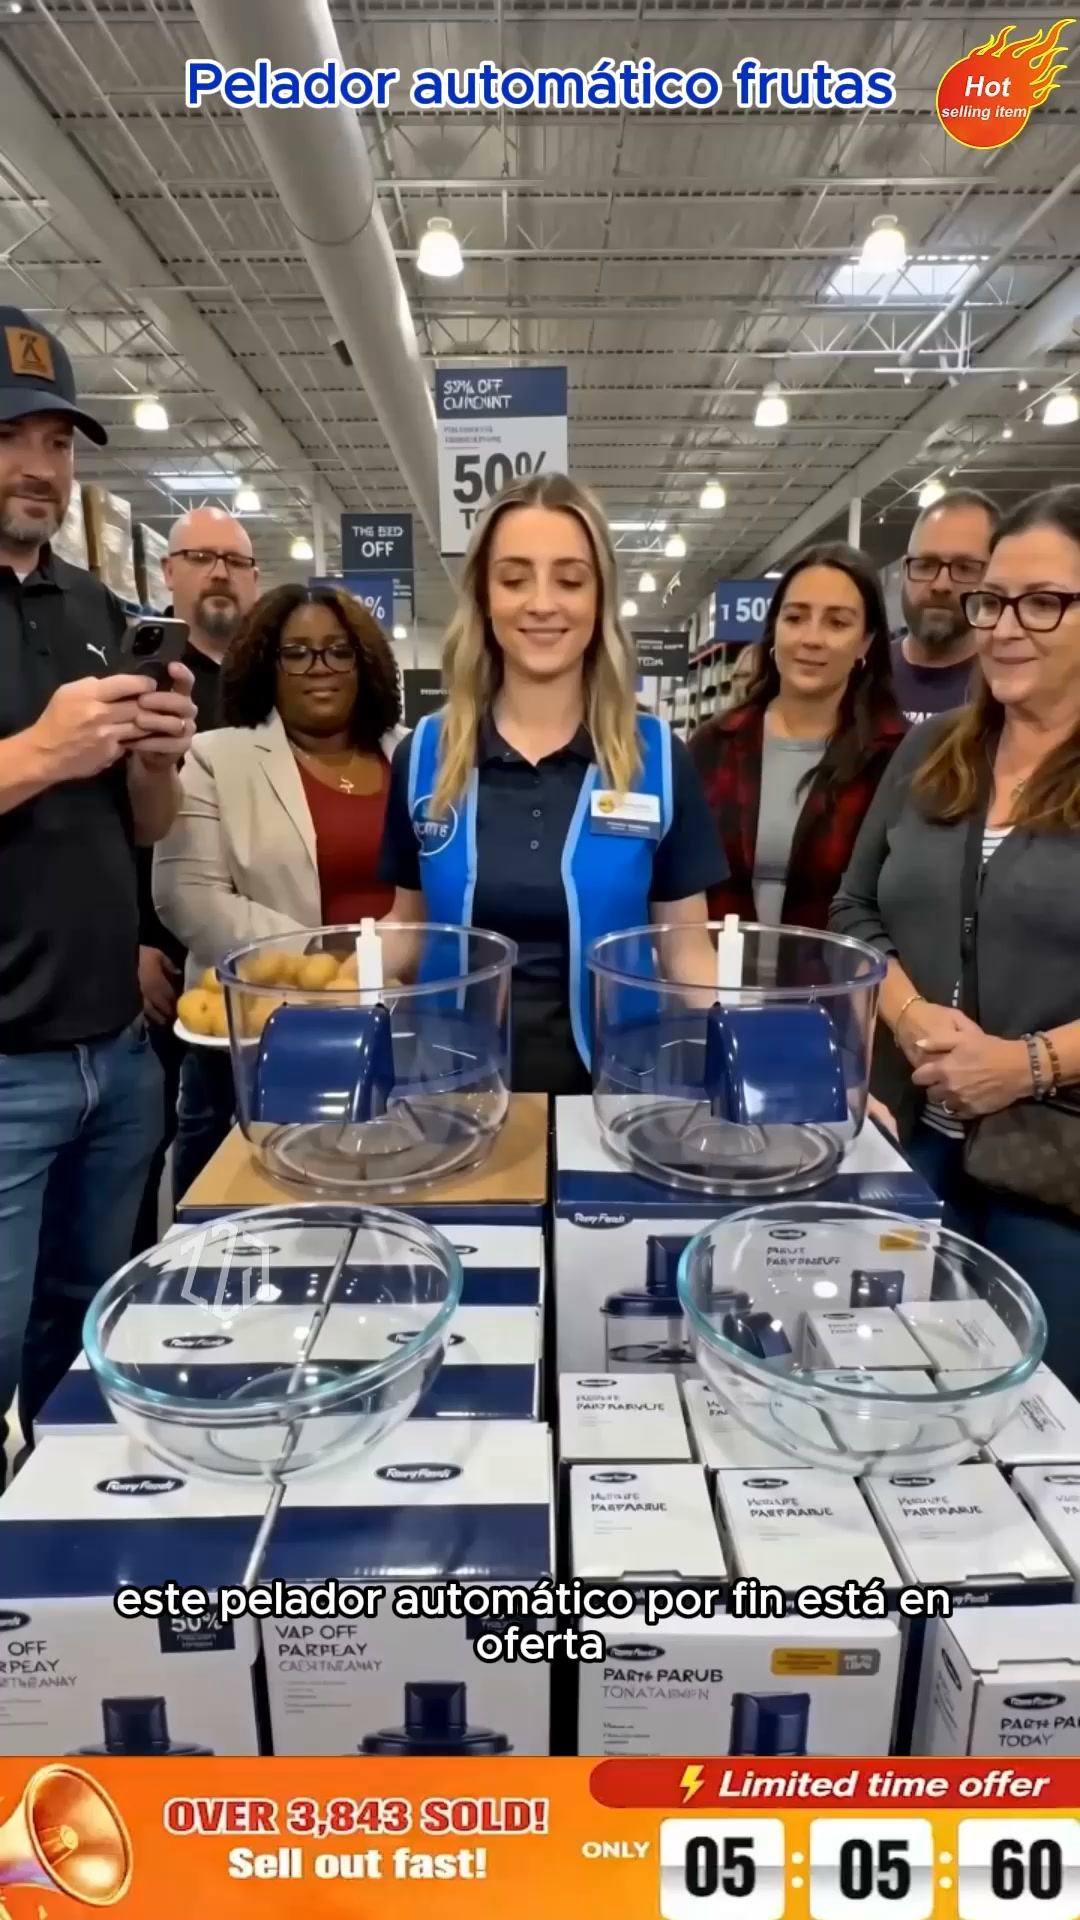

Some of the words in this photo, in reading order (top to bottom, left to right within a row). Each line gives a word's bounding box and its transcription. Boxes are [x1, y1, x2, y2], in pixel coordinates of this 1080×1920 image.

[361, 541, 395, 558] OFF
[275, 1624, 314, 1639] VAP
[319, 1624, 358, 1640] OFF
[7, 1640, 47, 1656] OFF
[999, 1733, 1053, 1748] TODAY
